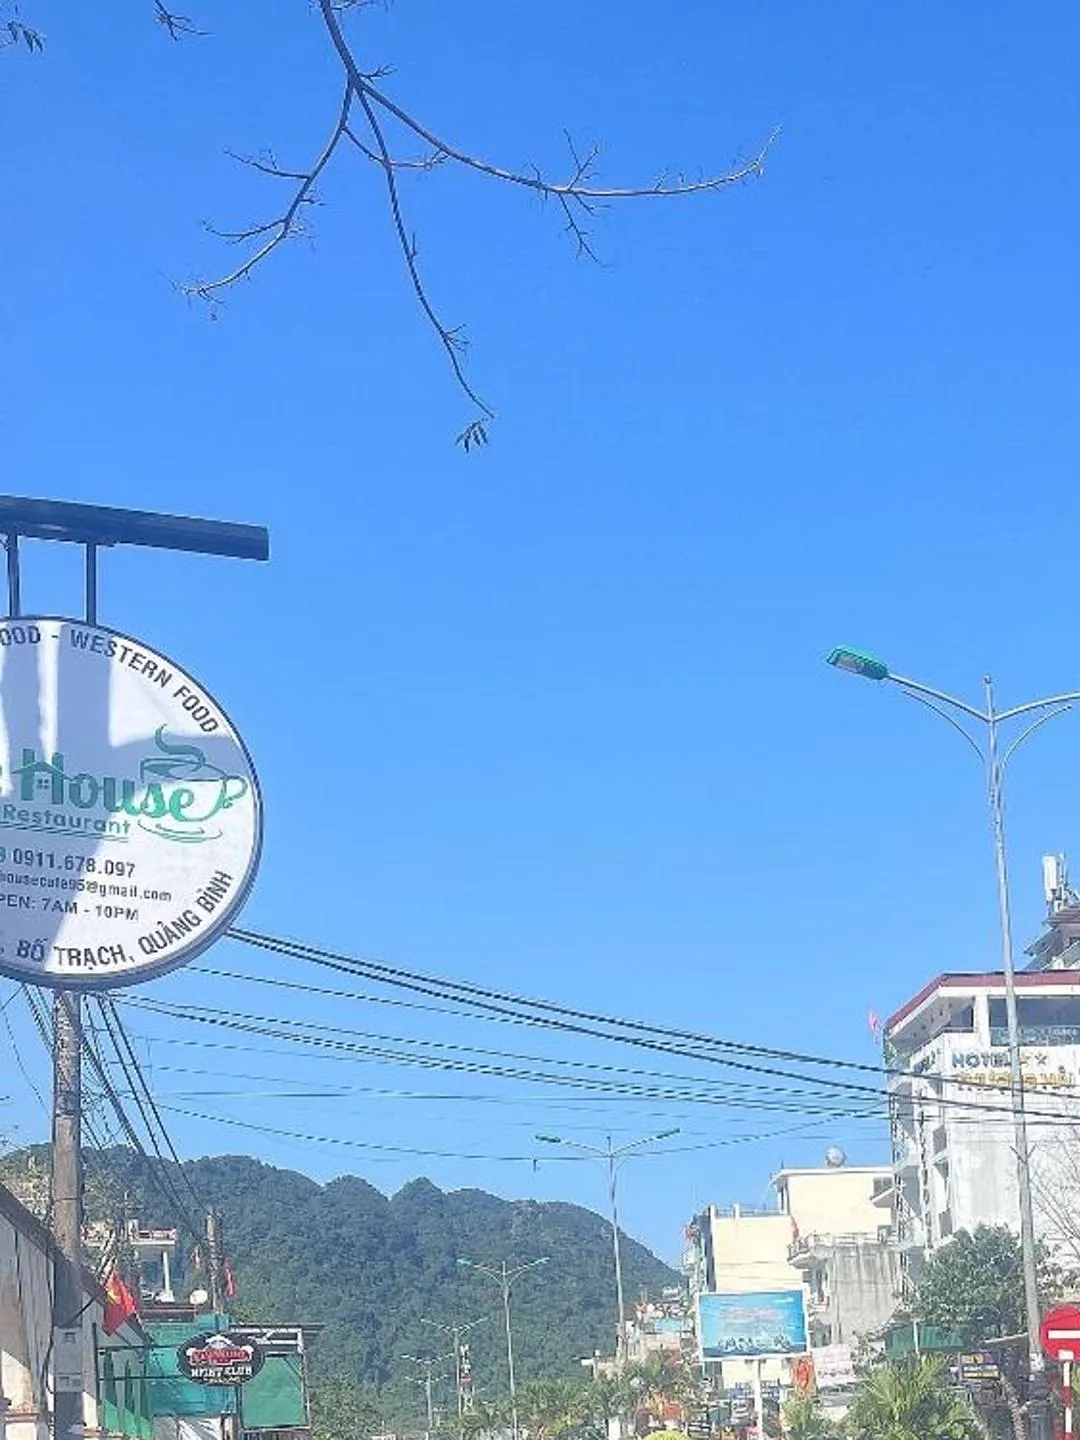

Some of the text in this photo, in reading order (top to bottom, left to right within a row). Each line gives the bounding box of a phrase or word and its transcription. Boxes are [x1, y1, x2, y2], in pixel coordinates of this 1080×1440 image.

[70, 629, 173, 689] WESTERN
[173, 685, 219, 733] FOOD
[14, 748, 215, 823] House
[3, 804, 131, 835] Restaurant
[13, 848, 136, 878] 0911.678.097
[41, 898, 78, 915] 7AM
[95, 905, 140, 921] 10PM
